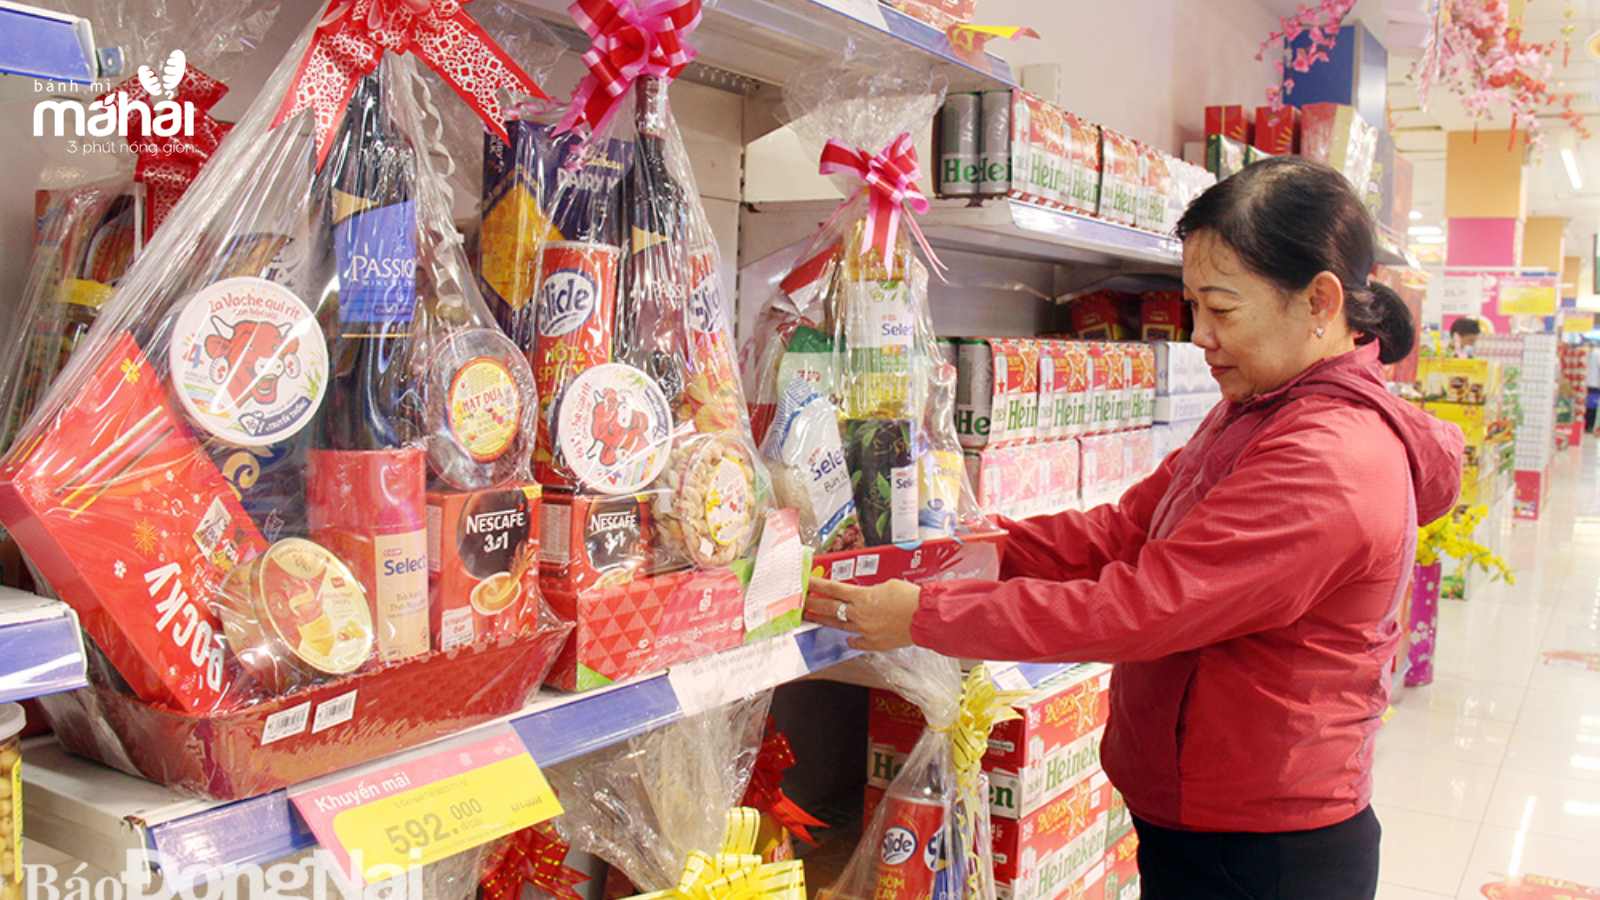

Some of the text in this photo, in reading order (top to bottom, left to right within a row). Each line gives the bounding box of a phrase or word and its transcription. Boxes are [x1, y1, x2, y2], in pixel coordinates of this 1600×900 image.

[222, 292, 264, 308] Vache
[143, 562, 224, 693] POCKY
[314, 780, 383, 813] Khuyến
[382, 770, 412, 796] mãi
